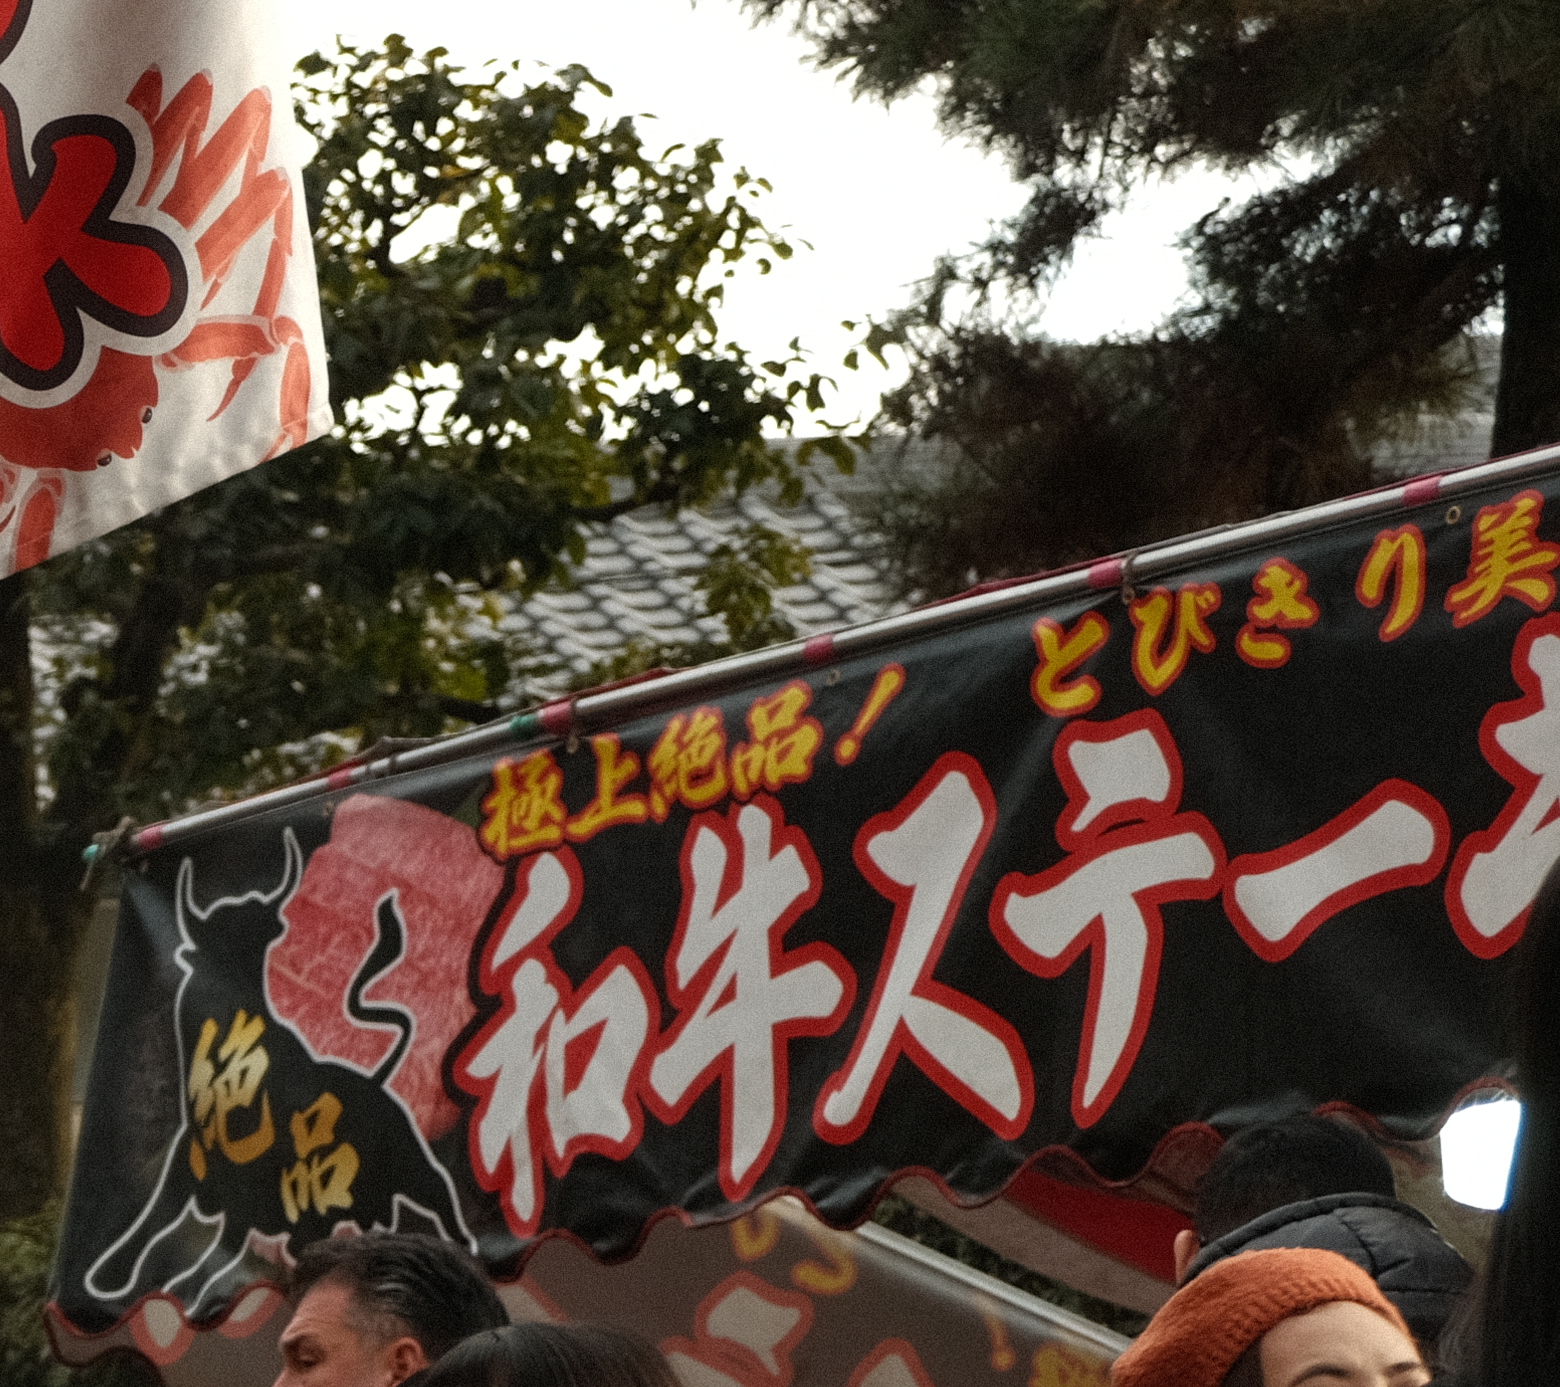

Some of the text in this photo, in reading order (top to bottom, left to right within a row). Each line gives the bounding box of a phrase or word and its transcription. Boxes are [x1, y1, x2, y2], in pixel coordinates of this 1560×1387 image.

[1030, 489, 1560, 717] とびきり美
[187, 1008, 362, 1225] 絶品
